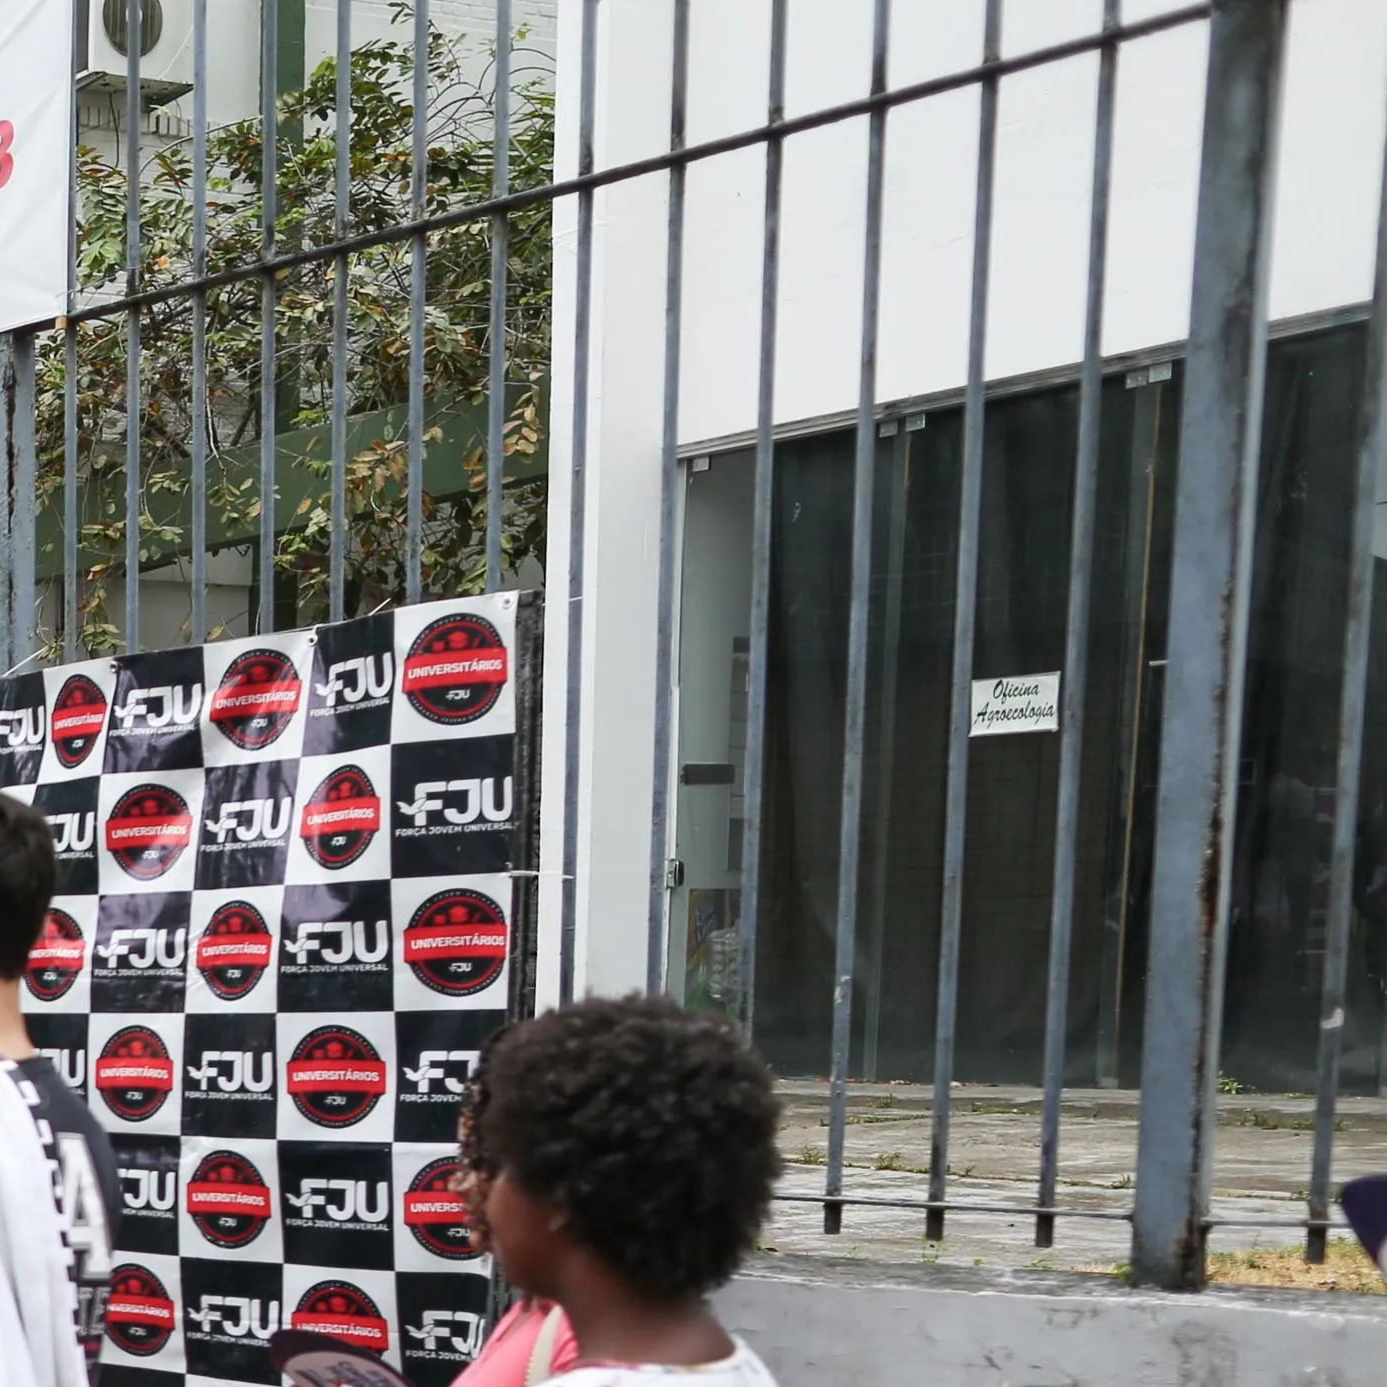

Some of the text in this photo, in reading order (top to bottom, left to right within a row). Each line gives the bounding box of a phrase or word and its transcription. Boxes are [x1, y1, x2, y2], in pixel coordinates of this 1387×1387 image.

[325, 651, 392, 707] FJU
[408, 657, 503, 679] UNIVERSITÁRIOS
[121, 683, 203, 729] FJU
[215, 691, 297, 709] UNIVERSITÁRIOS
[992, 679, 1041, 705] Oficina
[973, 700, 1055, 729] Agroecologia
[215, 797, 292, 843] FJU
[306, 806, 375, 825] UNIVERSITÁRIOS
[413, 776, 513, 827] FJU
[47, 811, 95, 853] JU
[395, 826, 427, 837] FORÇA
[429, 824, 463, 835] JOVEM
[108, 927, 186, 969] FJU
[297, 920, 388, 964] FJU
[411, 933, 506, 950] UNIVERSITÁRIOS
[280, 963, 389, 974] FORÇA JOVEM UNIVERSAL
[201, 1050, 274, 1092] FJU
[292, 1069, 380, 1082] UNIVERSITÁRIOS
[420, 1050, 481, 1094] FJ
[117, 1168, 176, 1211] JU
[192, 1191, 265, 1206] UNIVERSITÁRIOS
[301, 1178, 388, 1223] FJU
[200, 1294, 280, 1337] FJU
